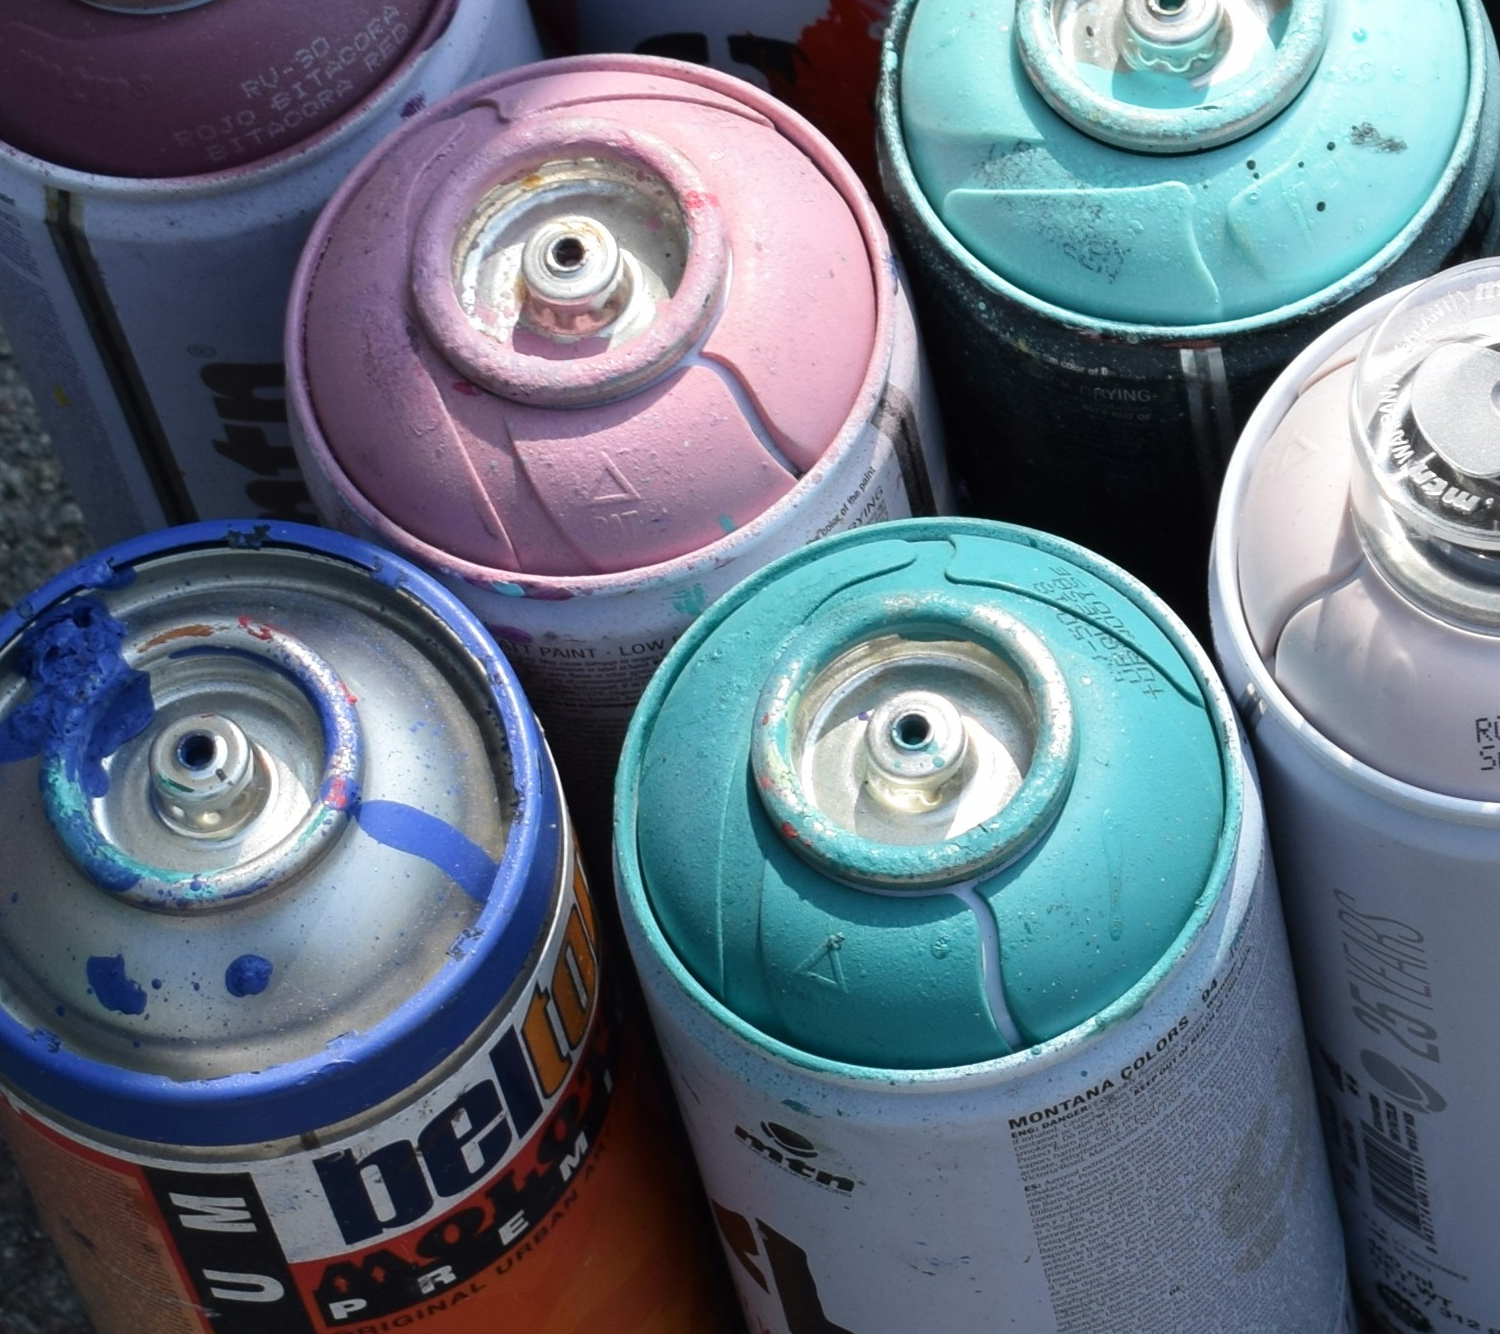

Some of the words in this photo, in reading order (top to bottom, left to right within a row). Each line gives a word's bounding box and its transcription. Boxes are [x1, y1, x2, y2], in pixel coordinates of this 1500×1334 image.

[858, 464, 878, 491] paint
[539, 645, 596, 659] PAINT
[618, 638, 665, 658] LOW
[1007, 1078, 1115, 1131] MONTANA
[1120, 1014, 1190, 1081] COLORS
[1041, 1104, 1092, 1130] DANGER:
[733, 1123, 856, 1193] mtn
[494, 1191, 579, 1276] URBAN
